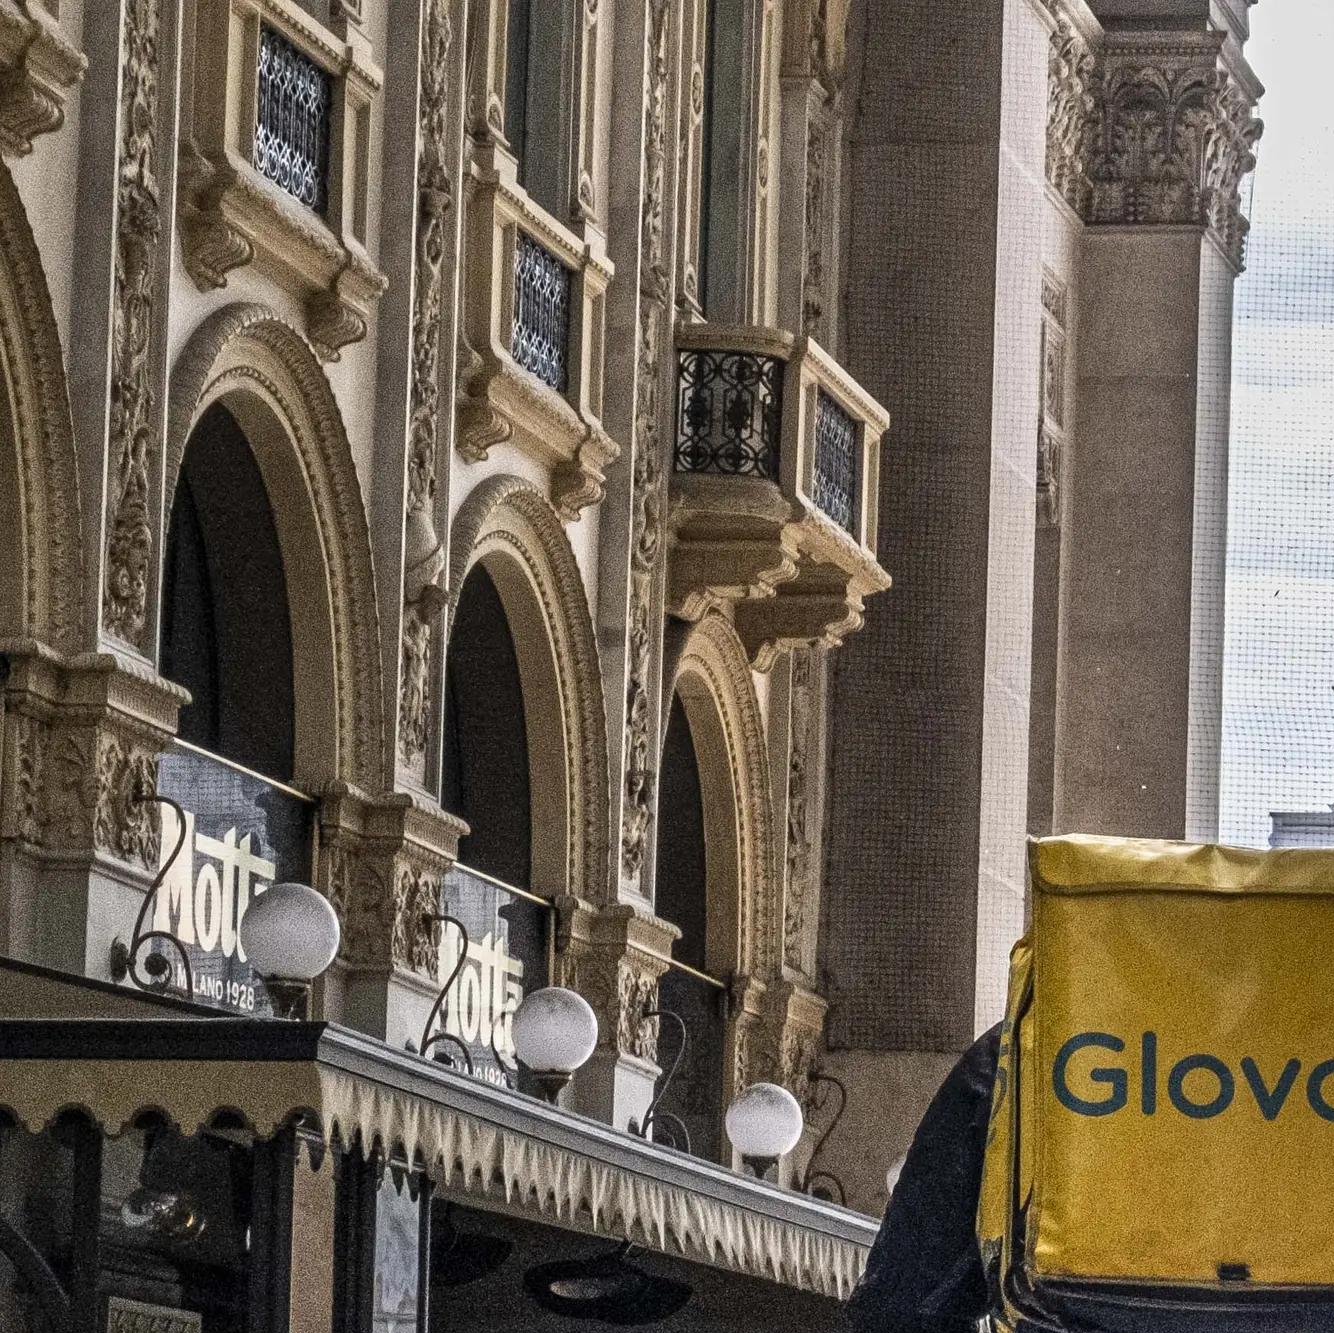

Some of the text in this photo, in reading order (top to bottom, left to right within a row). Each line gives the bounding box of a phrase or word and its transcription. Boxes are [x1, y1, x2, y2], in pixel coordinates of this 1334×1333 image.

[153, 801, 276, 963] Mott
[176, 963, 255, 1011] MLANO 1928
